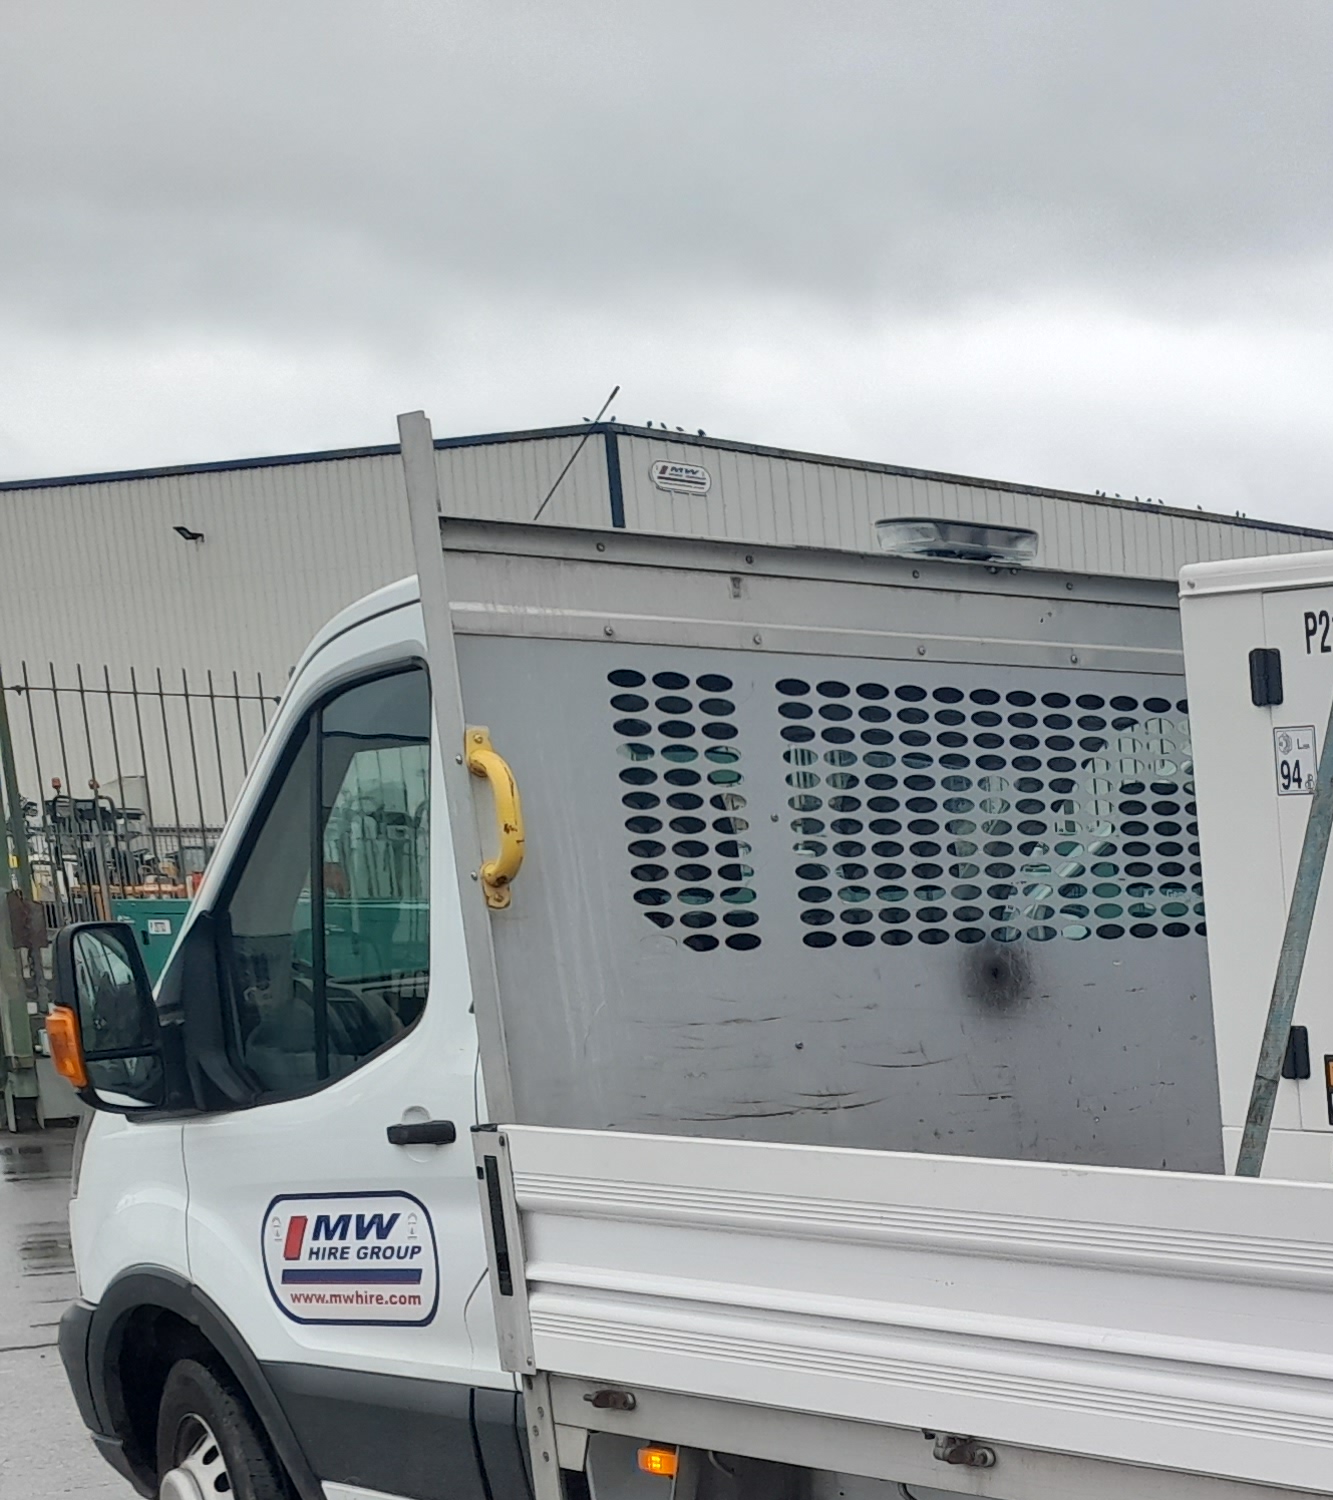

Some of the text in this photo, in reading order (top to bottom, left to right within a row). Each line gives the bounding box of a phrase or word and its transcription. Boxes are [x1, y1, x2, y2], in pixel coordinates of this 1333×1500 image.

[1280, 760, 1302, 790] 94
[312, 1213, 401, 1241] MW
[308, 1246, 422, 1260] HIRE GROUP
[290, 1291, 422, 1305] www.mwhire.com
